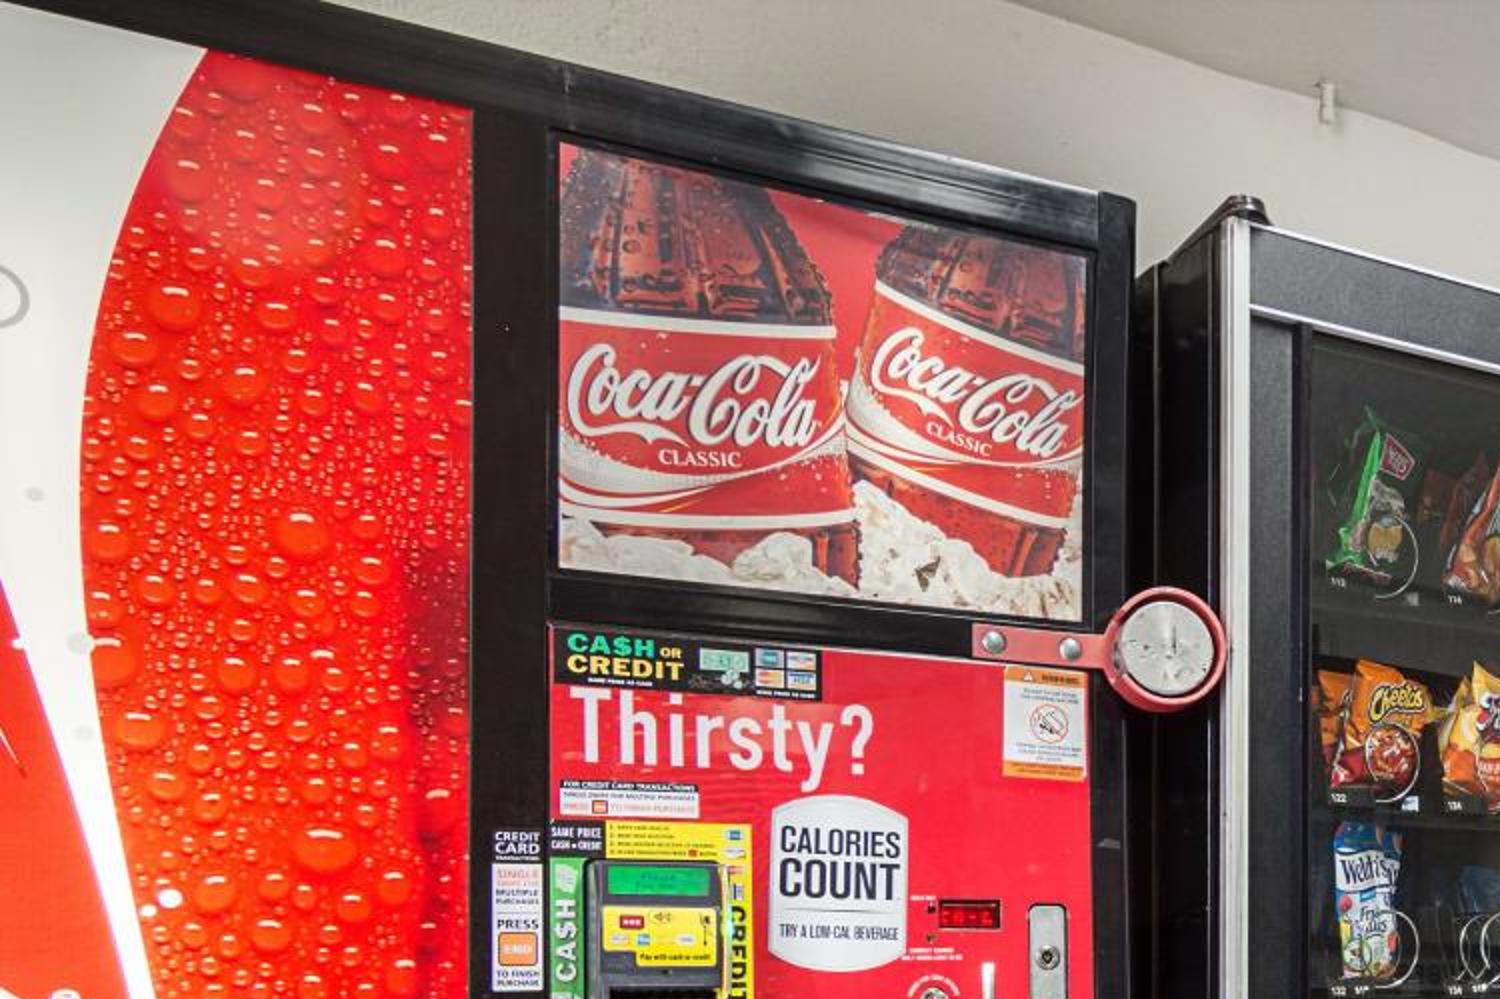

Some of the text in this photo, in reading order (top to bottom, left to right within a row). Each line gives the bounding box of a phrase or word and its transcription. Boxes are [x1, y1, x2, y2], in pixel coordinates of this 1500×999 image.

[567, 343, 822, 449] Coca-Cola
[871, 327, 1083, 458] Coca-Cola
[927, 421, 993, 457] CLASSIC
[658, 449, 743, 469] CLASSIC
[567, 655, 684, 680] CREDIT
[660, 647, 681, 658] OR
[569, 687, 874, 792] Thirsty?
[495, 831, 540, 842] CREDIT
[495, 842, 541, 854] CARD
[780, 824, 901, 860] CALORIES
[779, 861, 900, 903] COUNT
[497, 919, 539, 929] PRESS
[780, 924, 800, 939] TRY
[803, 925, 811, 939] A
[855, 925, 898, 941] BEVERAGE
[556, 900, 577, 982] CASH
